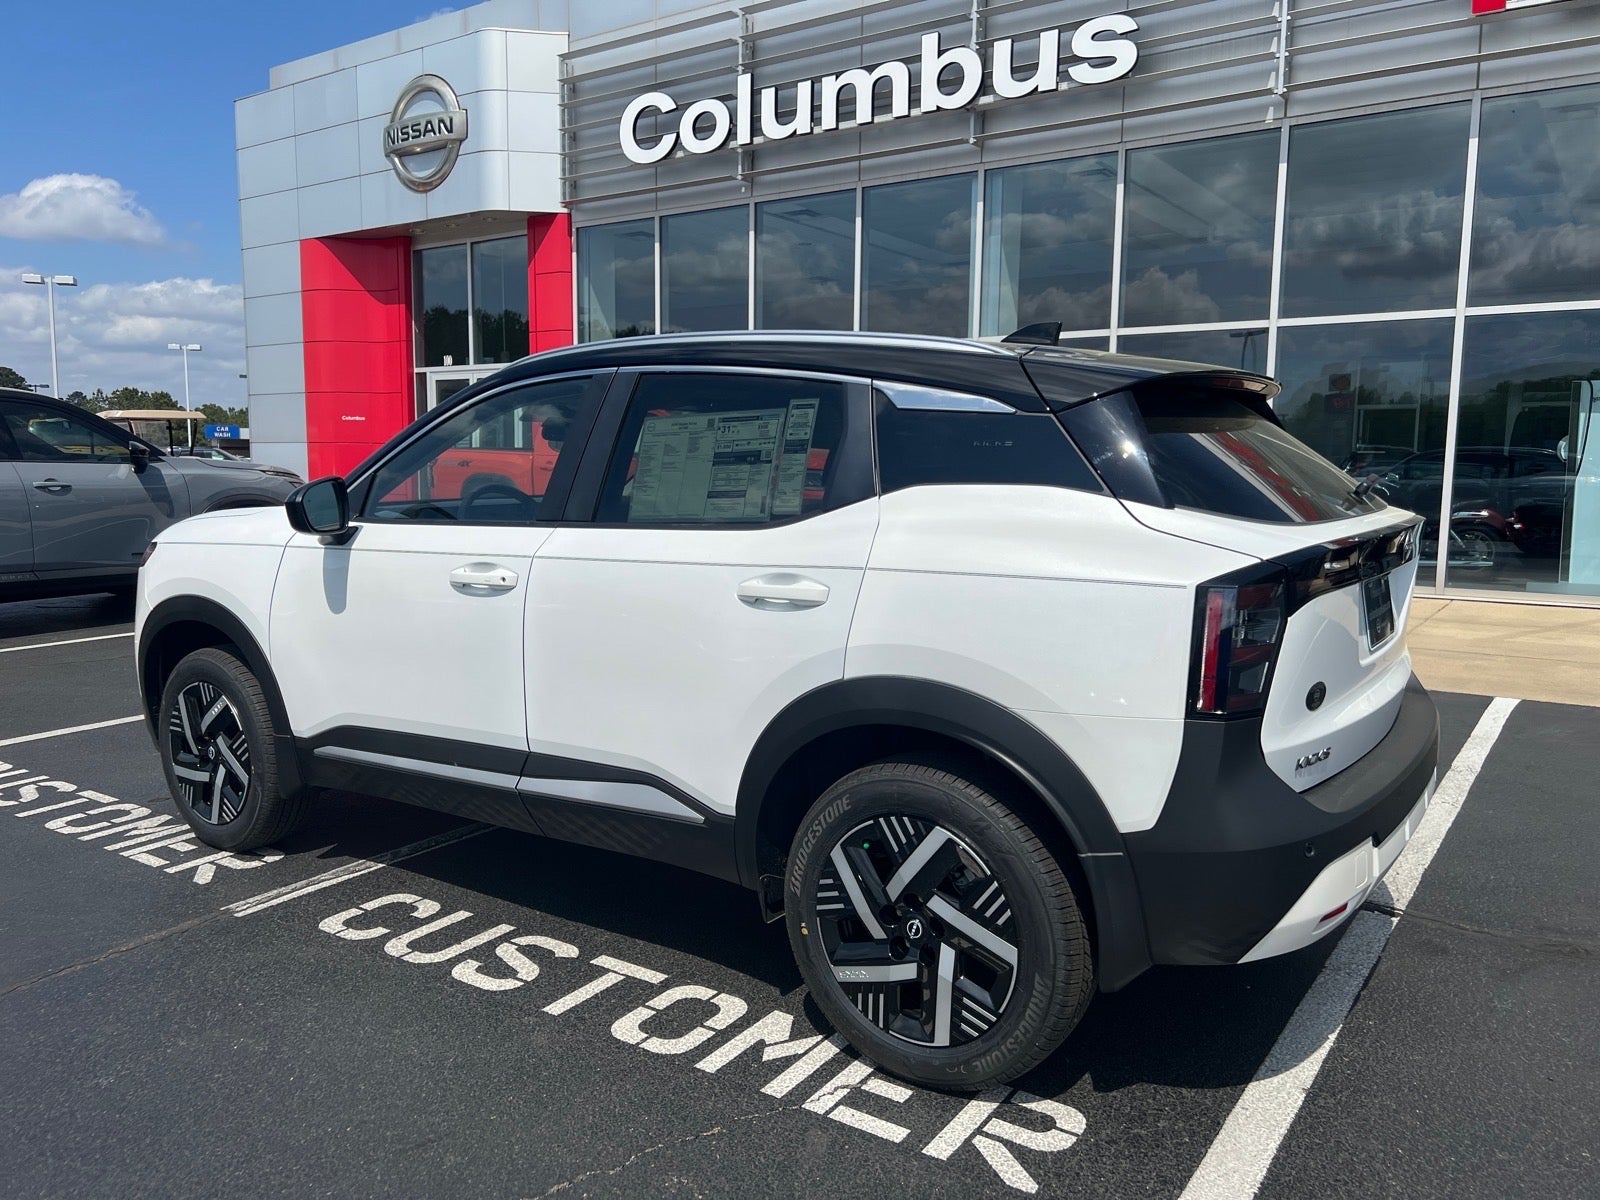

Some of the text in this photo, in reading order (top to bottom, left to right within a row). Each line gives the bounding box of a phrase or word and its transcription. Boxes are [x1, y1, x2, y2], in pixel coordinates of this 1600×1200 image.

[386, 115, 454, 147] NISSAN
[619, 14, 1141, 165] Columbus
[0, 760, 285, 885] USTOMER
[790, 794, 852, 898] BRIDGESTONE
[318, 893, 1087, 1194] CUSTOMER
